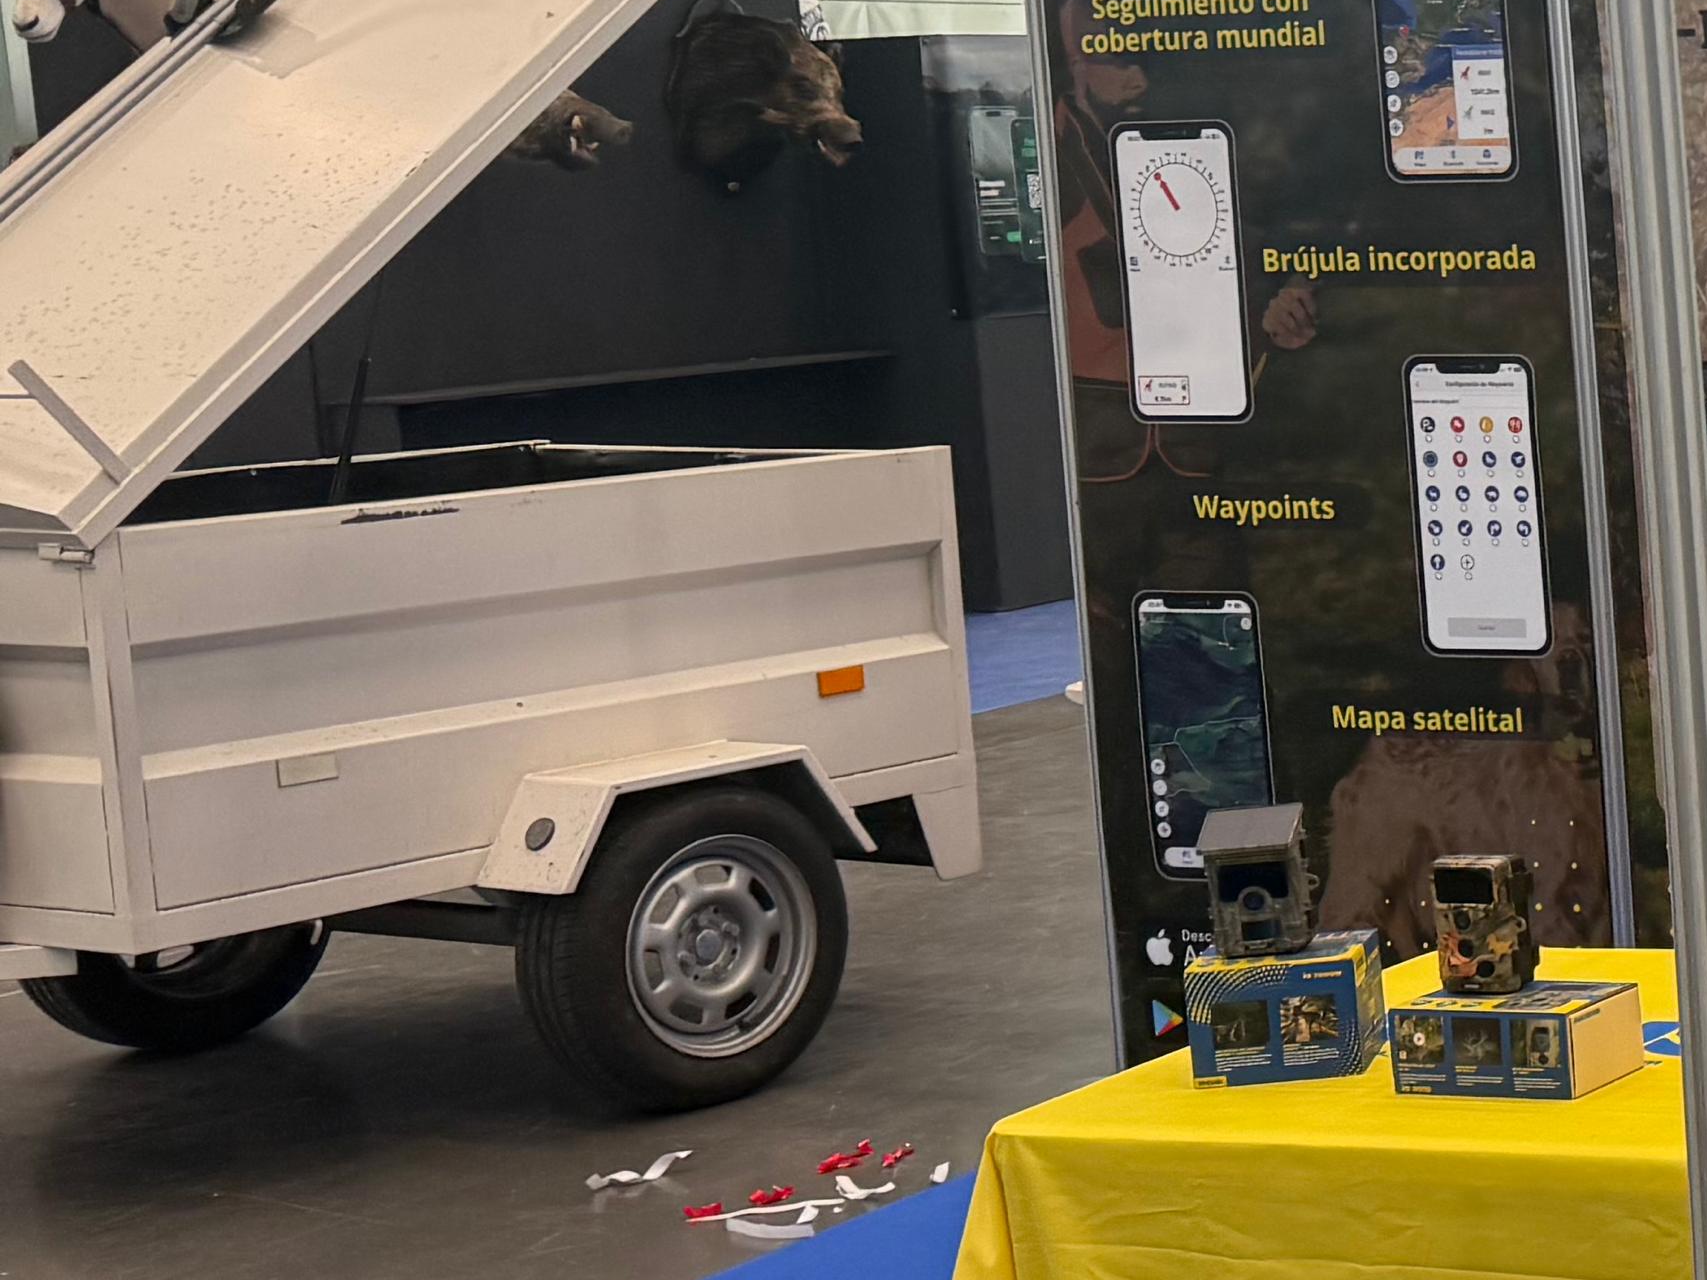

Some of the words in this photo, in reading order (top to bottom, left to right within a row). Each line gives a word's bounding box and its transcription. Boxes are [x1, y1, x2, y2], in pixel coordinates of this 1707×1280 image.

[1081, 24, 1209, 54] cobertura
[1216, 20, 1326, 50] mundial
[1262, 247, 1361, 280] Brújula
[1368, 244, 1536, 277] incorporada
[1193, 495, 1336, 526] Waypoints
[1332, 705, 1406, 735] Mapa
[1412, 706, 1524, 733] satelital
